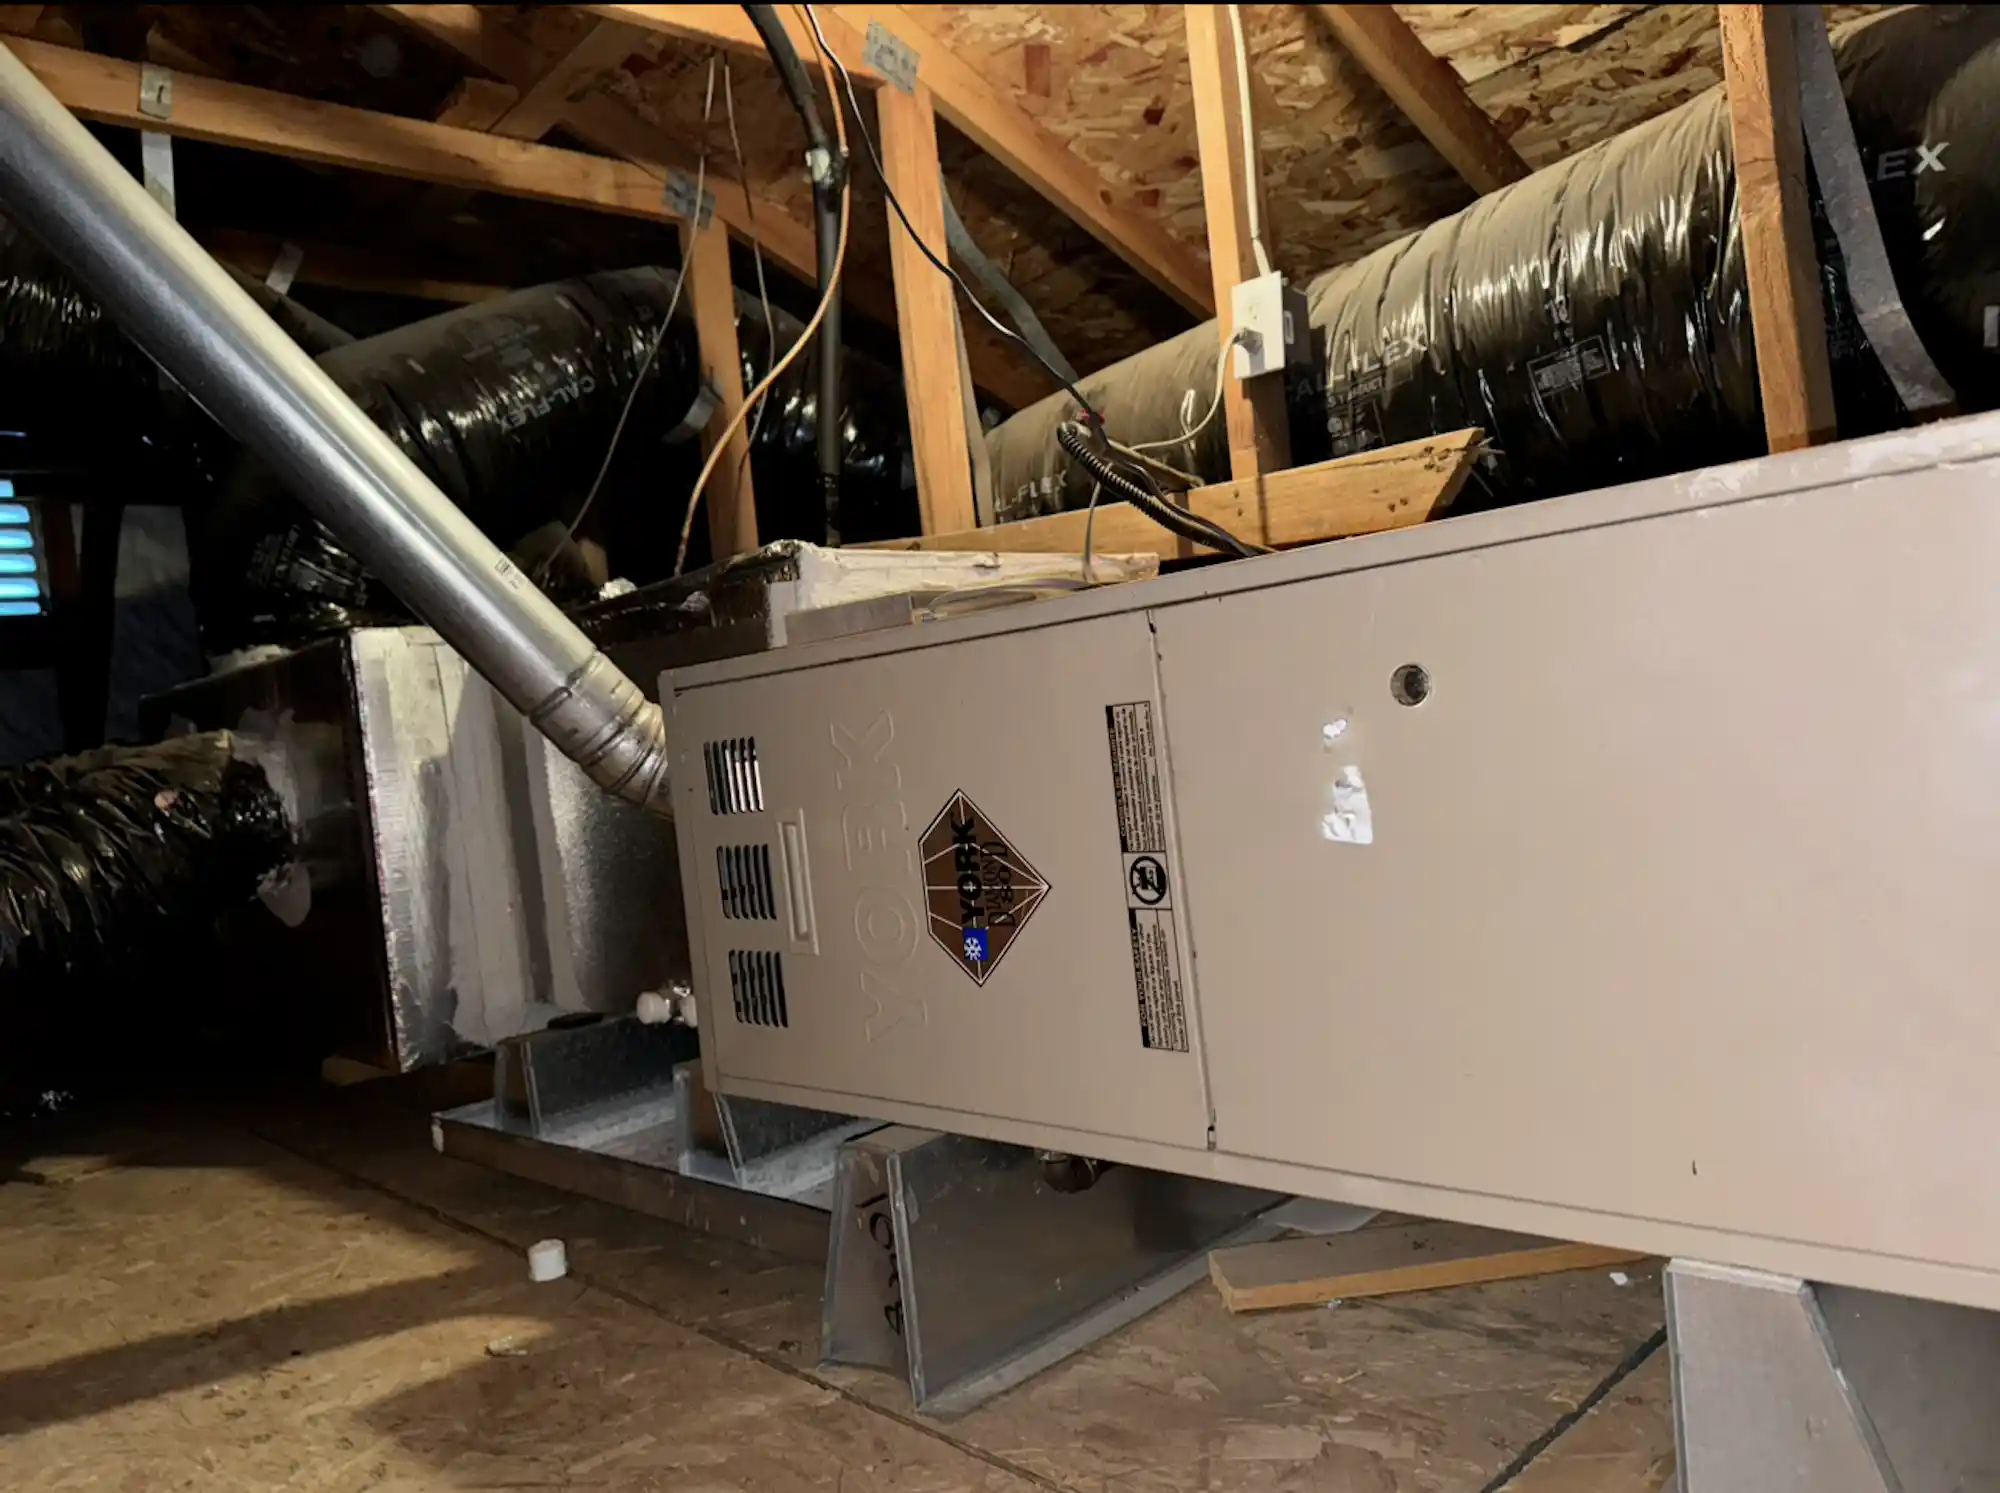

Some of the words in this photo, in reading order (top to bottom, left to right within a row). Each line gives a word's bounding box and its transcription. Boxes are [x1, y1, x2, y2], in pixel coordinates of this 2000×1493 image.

[830, 708, 928, 1043] YORK
[949, 810, 985, 927] YORK
[979, 841, 1016, 927] DIAMOND
